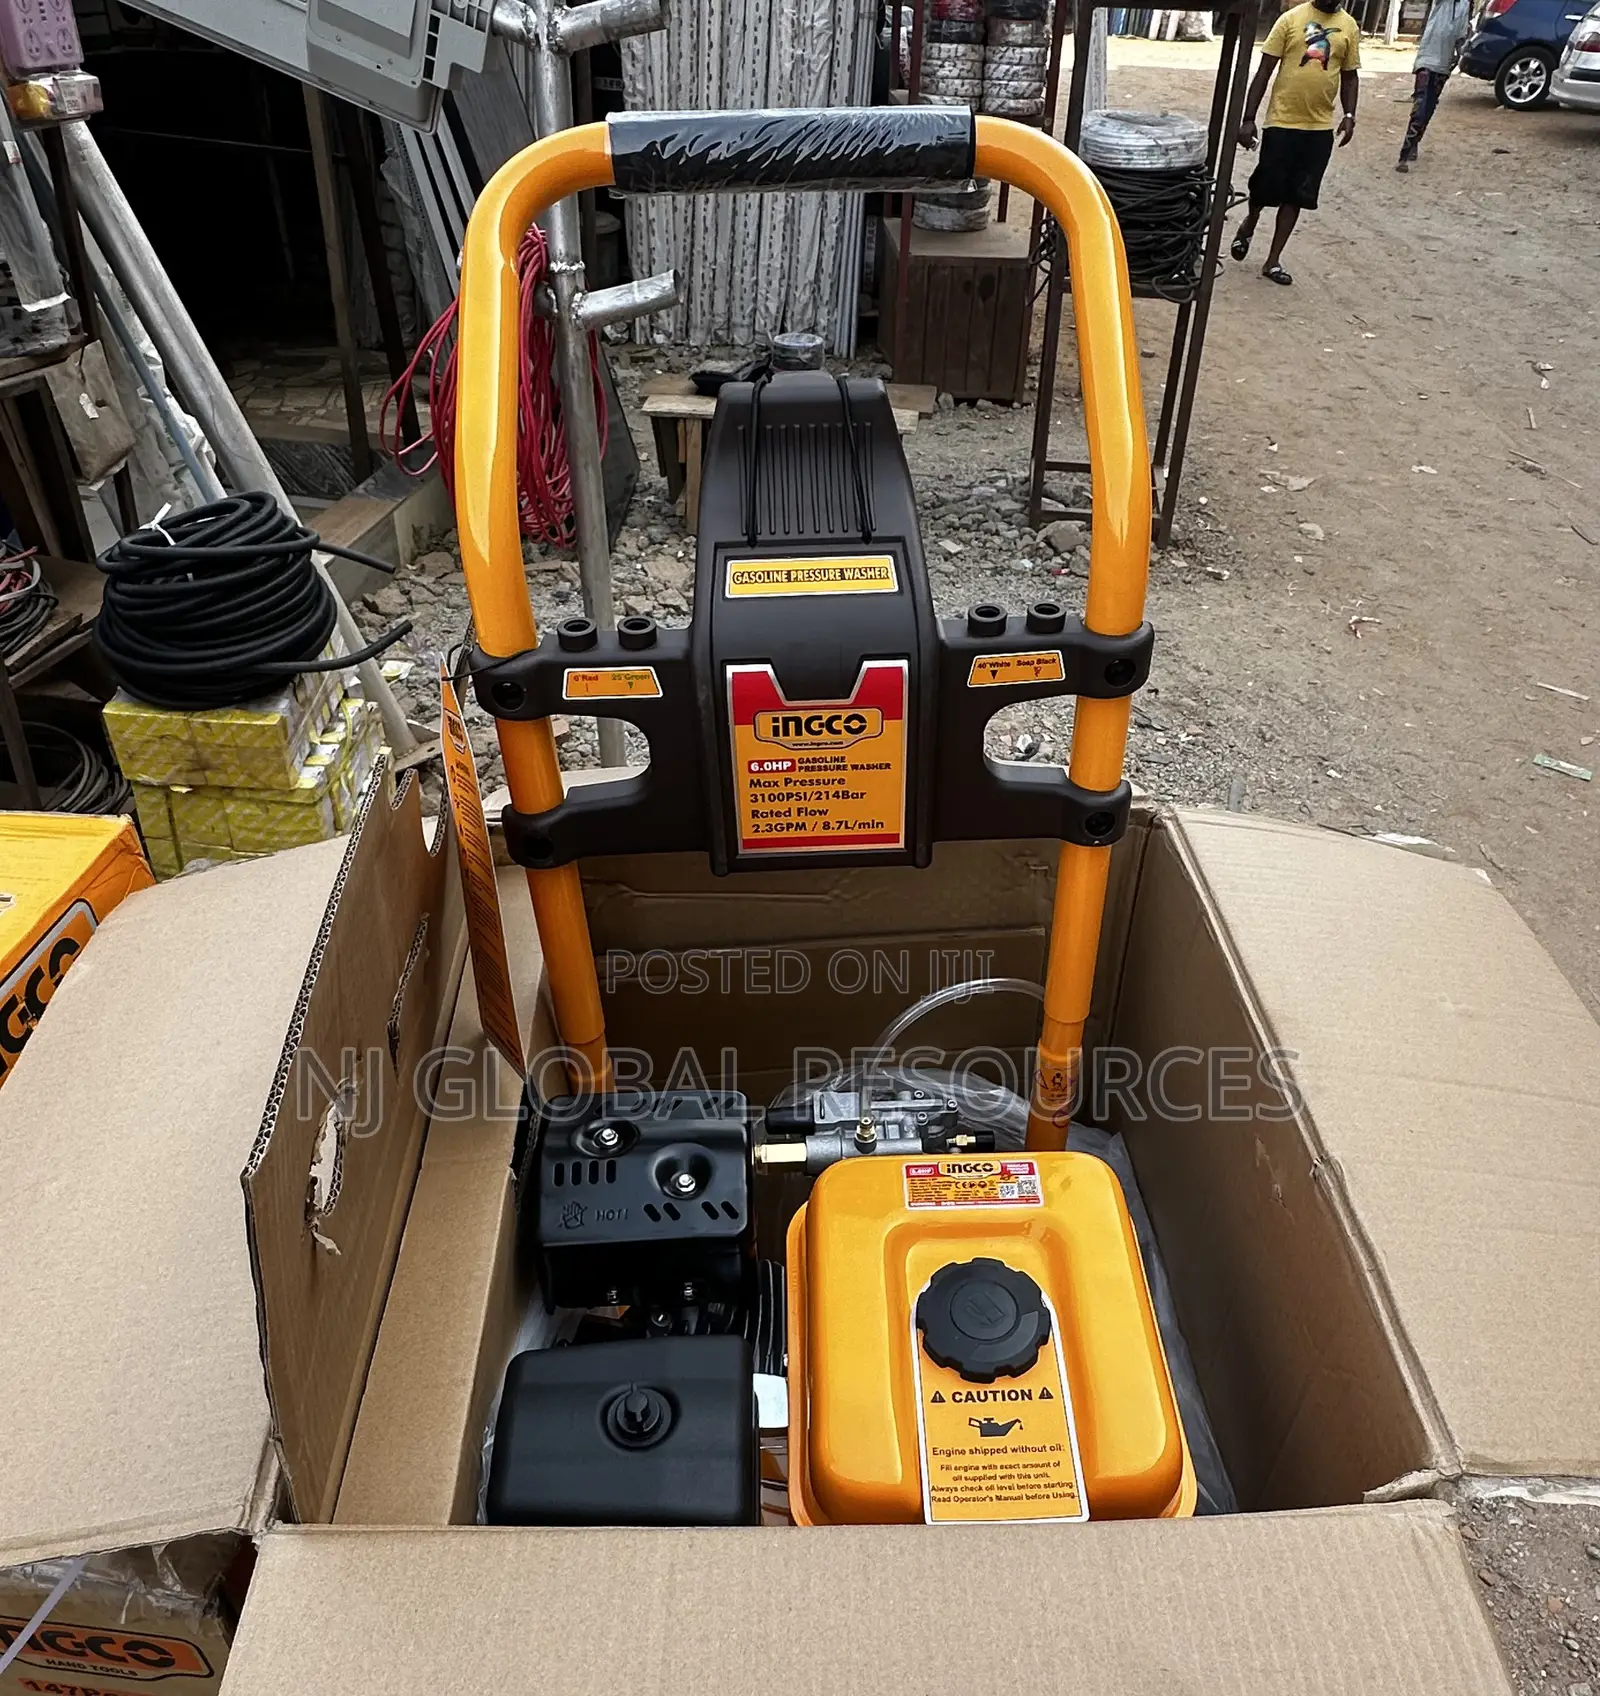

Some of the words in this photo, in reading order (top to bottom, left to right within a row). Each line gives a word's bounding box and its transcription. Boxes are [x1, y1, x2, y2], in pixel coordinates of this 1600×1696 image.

[733, 570, 789, 584] GASOLINE
[790, 568, 842, 582] PRESSURE
[843, 566, 889, 580] WASHER
[1016, 659, 1034, 667] Soap
[750, 760, 792, 772] 6.0HP
[797, 756, 846, 765] GASOLINE
[798, 763, 848, 773] PRESSURE
[850, 763, 892, 771] WASHER
[749, 778, 780, 789] Max
[783, 776, 846, 788] Pressure
[750, 790, 867, 804] 3100PSI/214Bar
[751, 808, 792, 819] Rated
[796, 807, 829, 817] Flow
[752, 822, 807, 834] 2.3GPM
[811, 822, 818, 832] /
[821, 819, 884, 831] 8.7L/min
[595, 1208, 628, 1221] HOT!
[951, 1388, 1033, 1403] CAUTION
[932, 1447, 966, 1457] Engine
[969, 1446, 1008, 1456] shipped
[1010, 1445, 1047, 1453] without
[954, 1464, 979, 1472] engine
[1022, 1461, 1051, 1469] amount
[1053, 1460, 1061, 1468] of
[964, 1474, 997, 1482] supplied
[931, 1485, 958, 1493] Always
[953, 1493, 994, 1503] Operator's
[996, 1492, 1024, 1500] Manual
[1026, 1491, 1050, 1499] before
[45, 1658, 87, 1670] HAND
[89, 1664, 139, 1677] TOOLS
